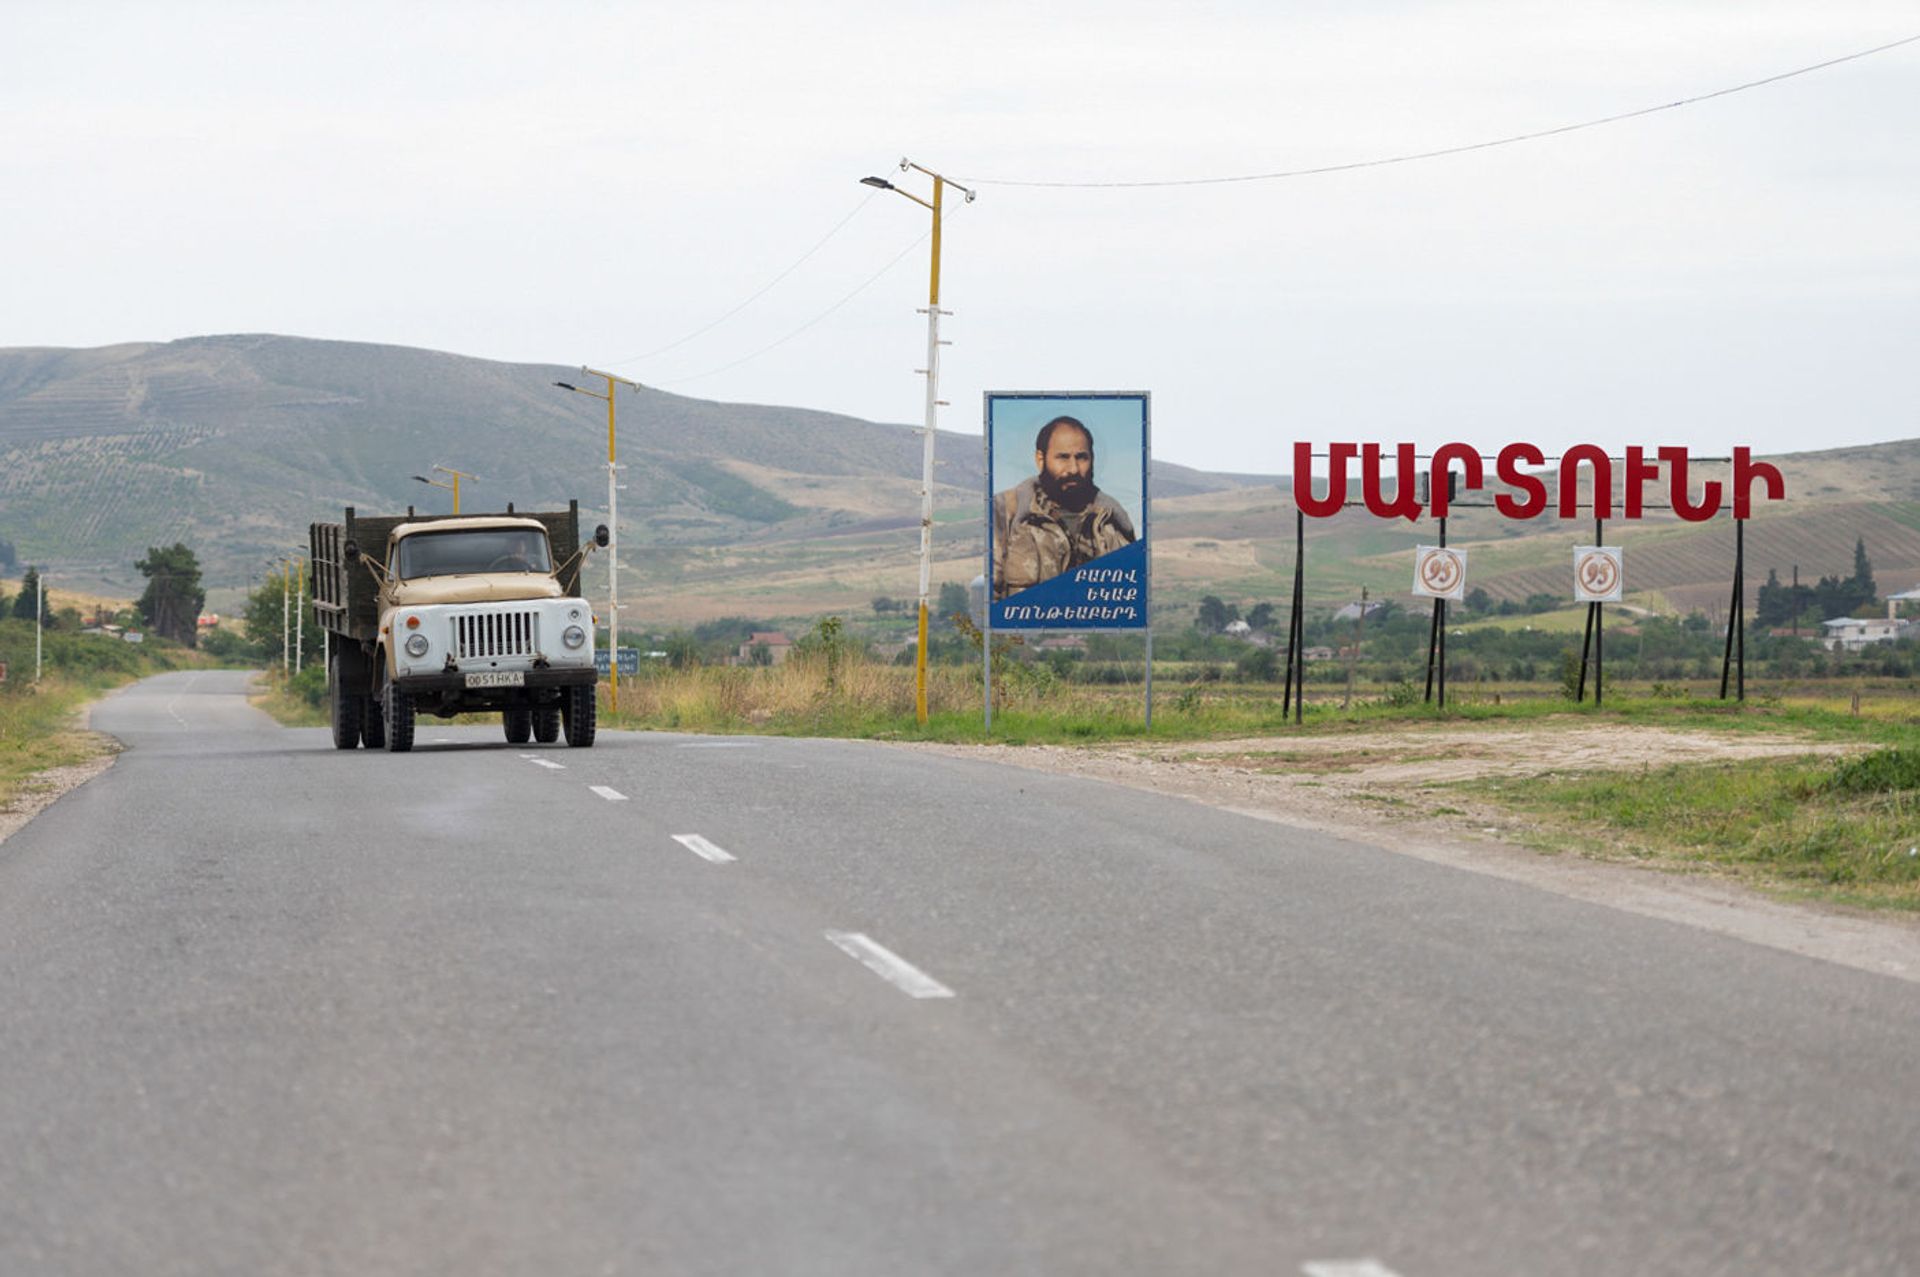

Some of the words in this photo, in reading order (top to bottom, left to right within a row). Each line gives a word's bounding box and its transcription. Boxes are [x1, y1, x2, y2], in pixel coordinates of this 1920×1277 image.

[1293, 442, 1785, 522] ՄԱՐՏՈՒՆԻ
[1074, 568, 1137, 583] ԲԱՐՈՎ
[1086, 587, 1137, 601] ԵԿԱՔ
